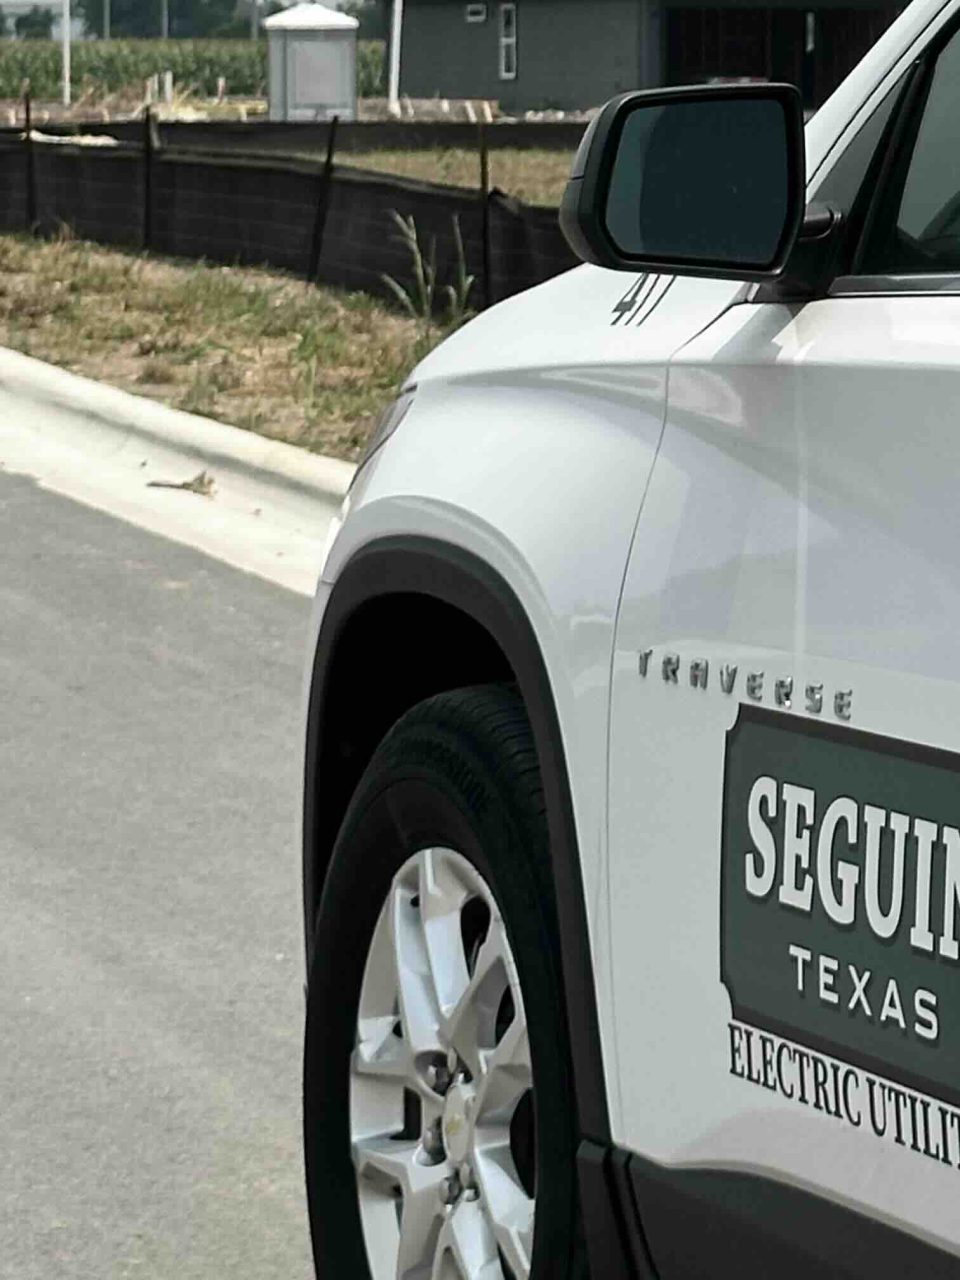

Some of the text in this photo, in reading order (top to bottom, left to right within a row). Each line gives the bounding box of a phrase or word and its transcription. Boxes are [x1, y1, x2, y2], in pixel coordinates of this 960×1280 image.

[638, 648, 854, 721] TRAVERSE
[788, 944, 938, 1040] TEXAS
[728, 1022, 861, 1128] ELECTRIC
